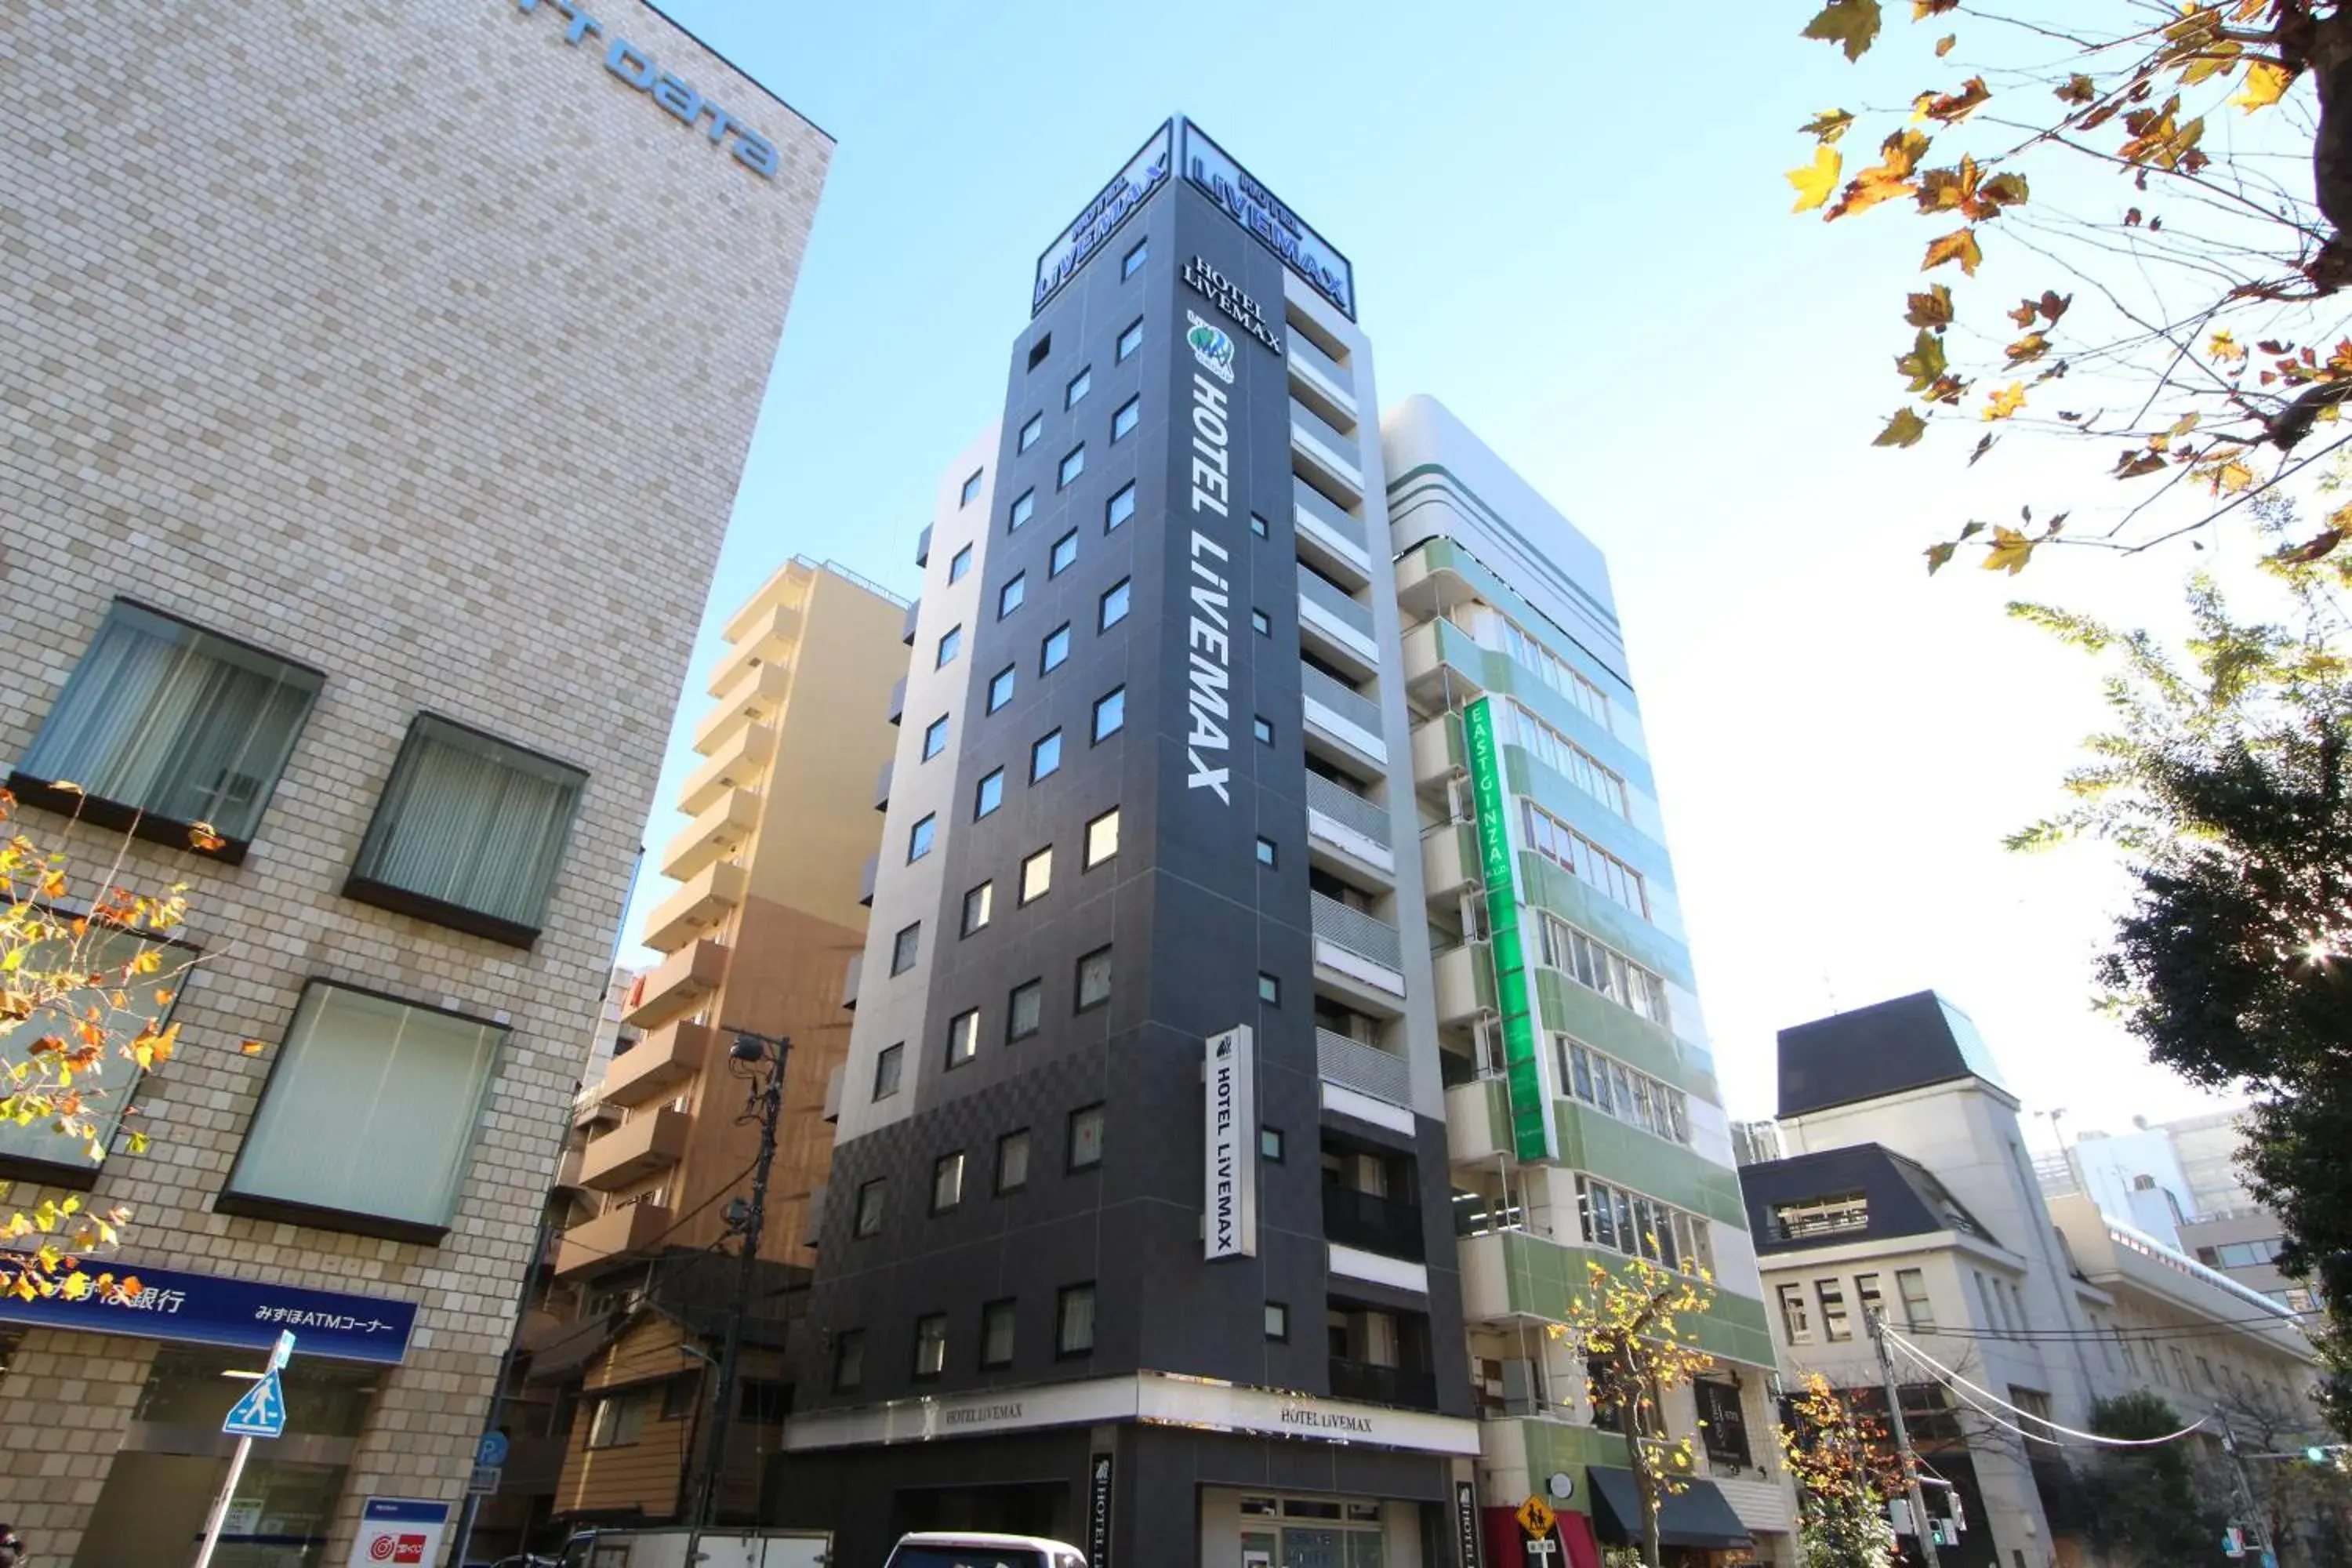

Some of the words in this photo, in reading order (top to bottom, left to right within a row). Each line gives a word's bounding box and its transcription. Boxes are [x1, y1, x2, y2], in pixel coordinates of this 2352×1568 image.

[1194, 254, 1267, 326] HOTEL
[1192, 372, 1229, 517] HOTEL
[1471, 707, 1487, 771] EAST
[1479, 776, 1503, 862] GINZA
[1218, 1067, 1231, 1137] HOTEL
[255, 1305, 394, 1333] みずほATMコーナー
[946, 1409, 975, 1424] HOTEL
[1282, 1408, 1318, 1426] HOTEL
[1095, 1487, 1106, 1550] HOTEL
